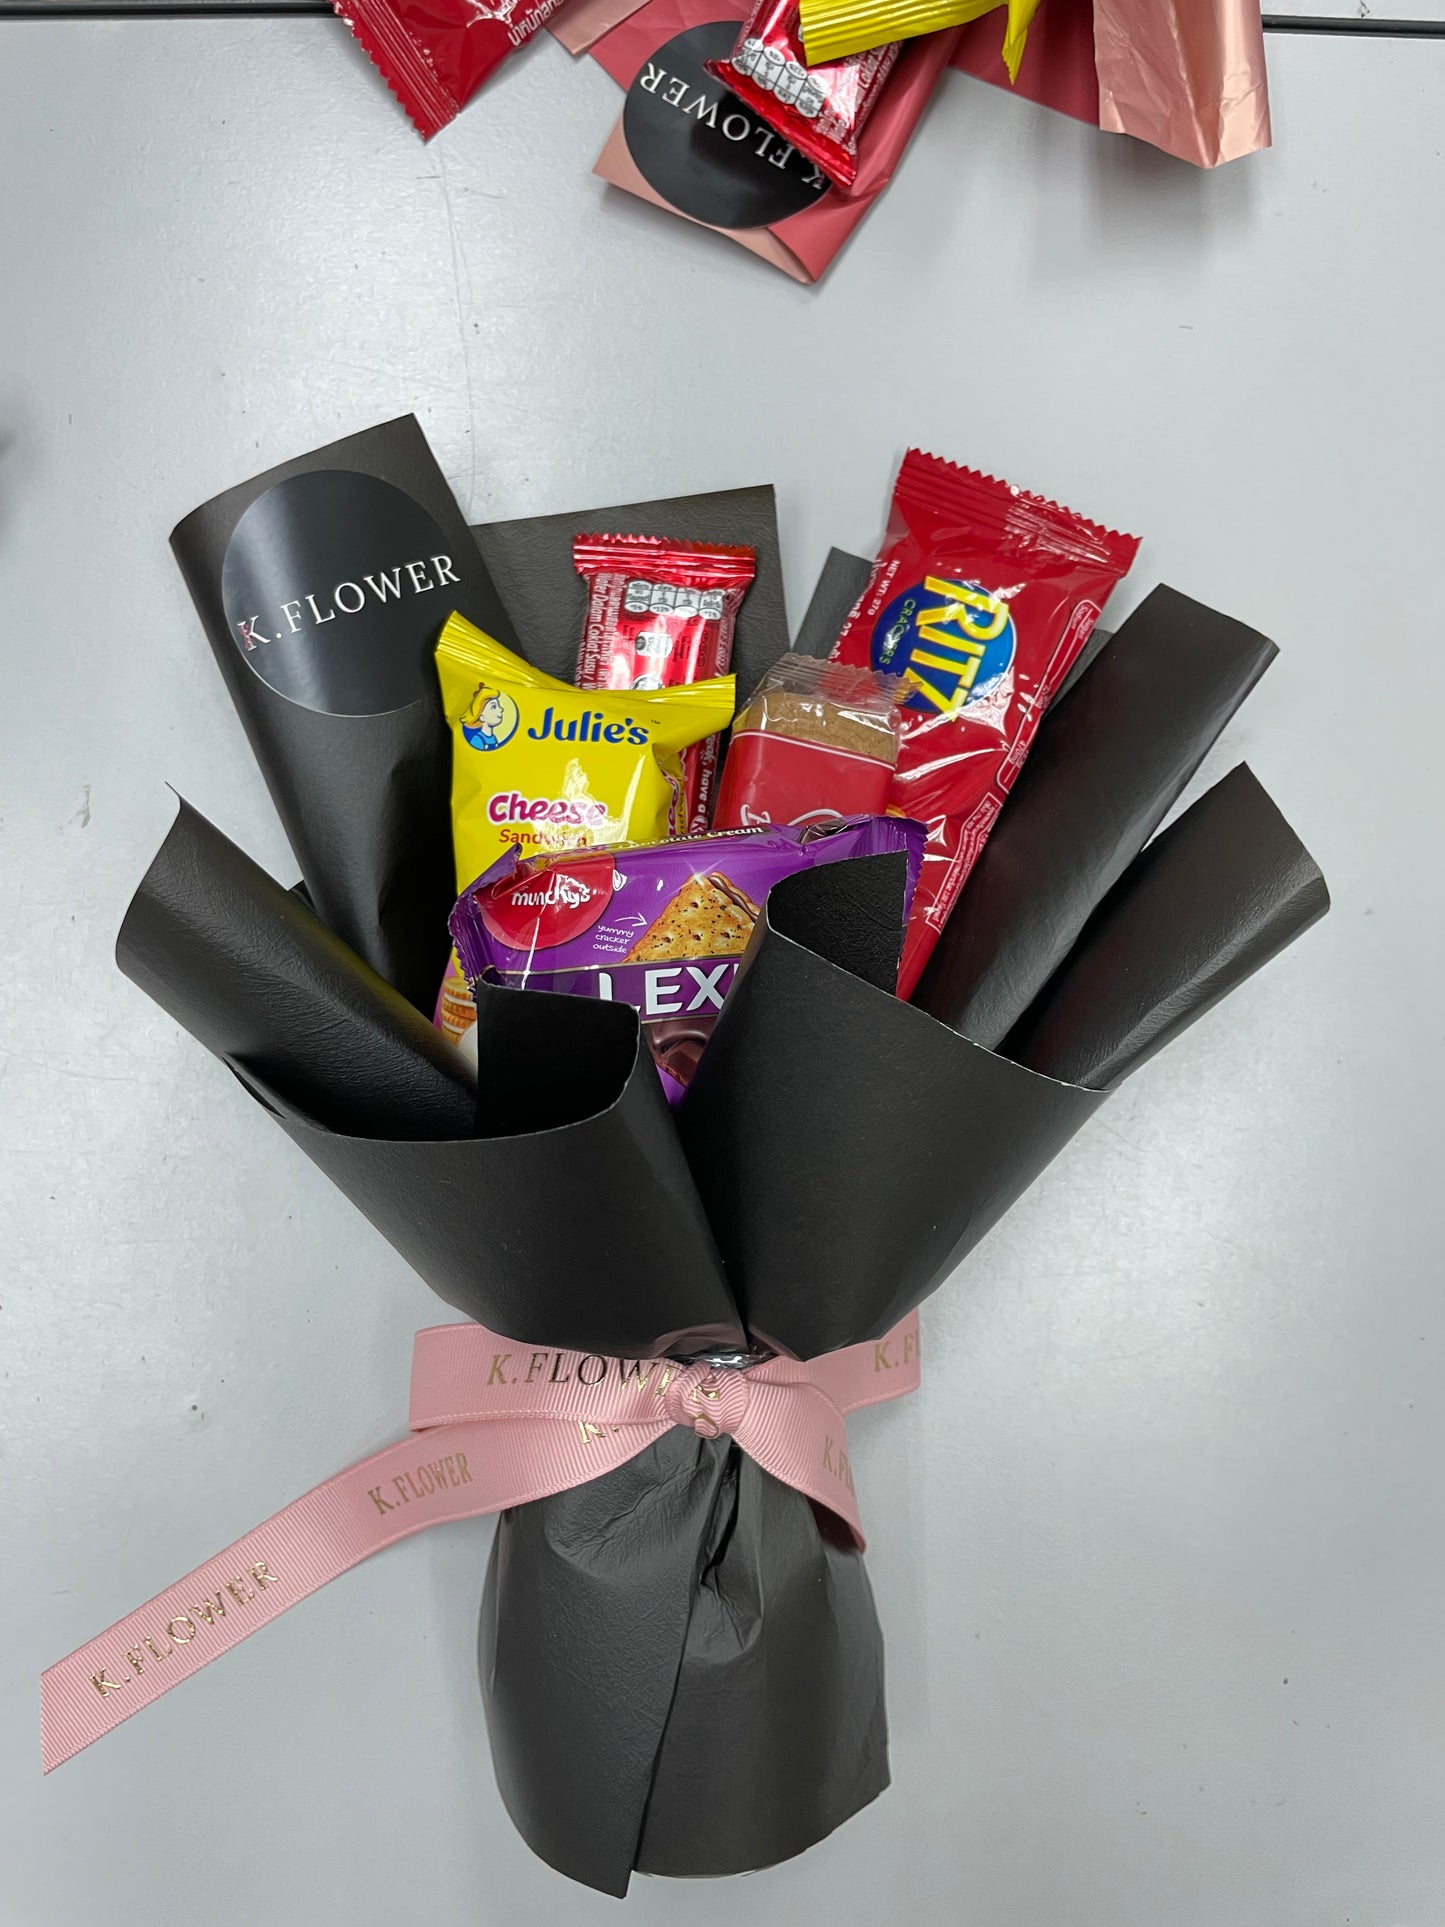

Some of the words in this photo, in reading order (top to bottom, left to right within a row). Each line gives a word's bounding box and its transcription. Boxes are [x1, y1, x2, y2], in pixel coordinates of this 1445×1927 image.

[640, 62, 826, 189] KFLOWER
[237, 555, 461, 651] K.FLOWER
[587, 624, 604, 653] Coklat
[879, 599, 916, 665] CRACRS
[895, 575, 1010, 723] RITZ
[527, 706, 650, 746] Julie's
[699, 768, 713, 801] have
[487, 791, 608, 828] Cheese
[592, 943, 627, 954] outside
[595, 934, 630, 945] cracker
[597, 925, 634, 938] yummy
[599, 963, 740, 1016] LEX
[367, 1451, 474, 1515] K.FLOWER
[89, 1560, 280, 1698] K.FLOWER
